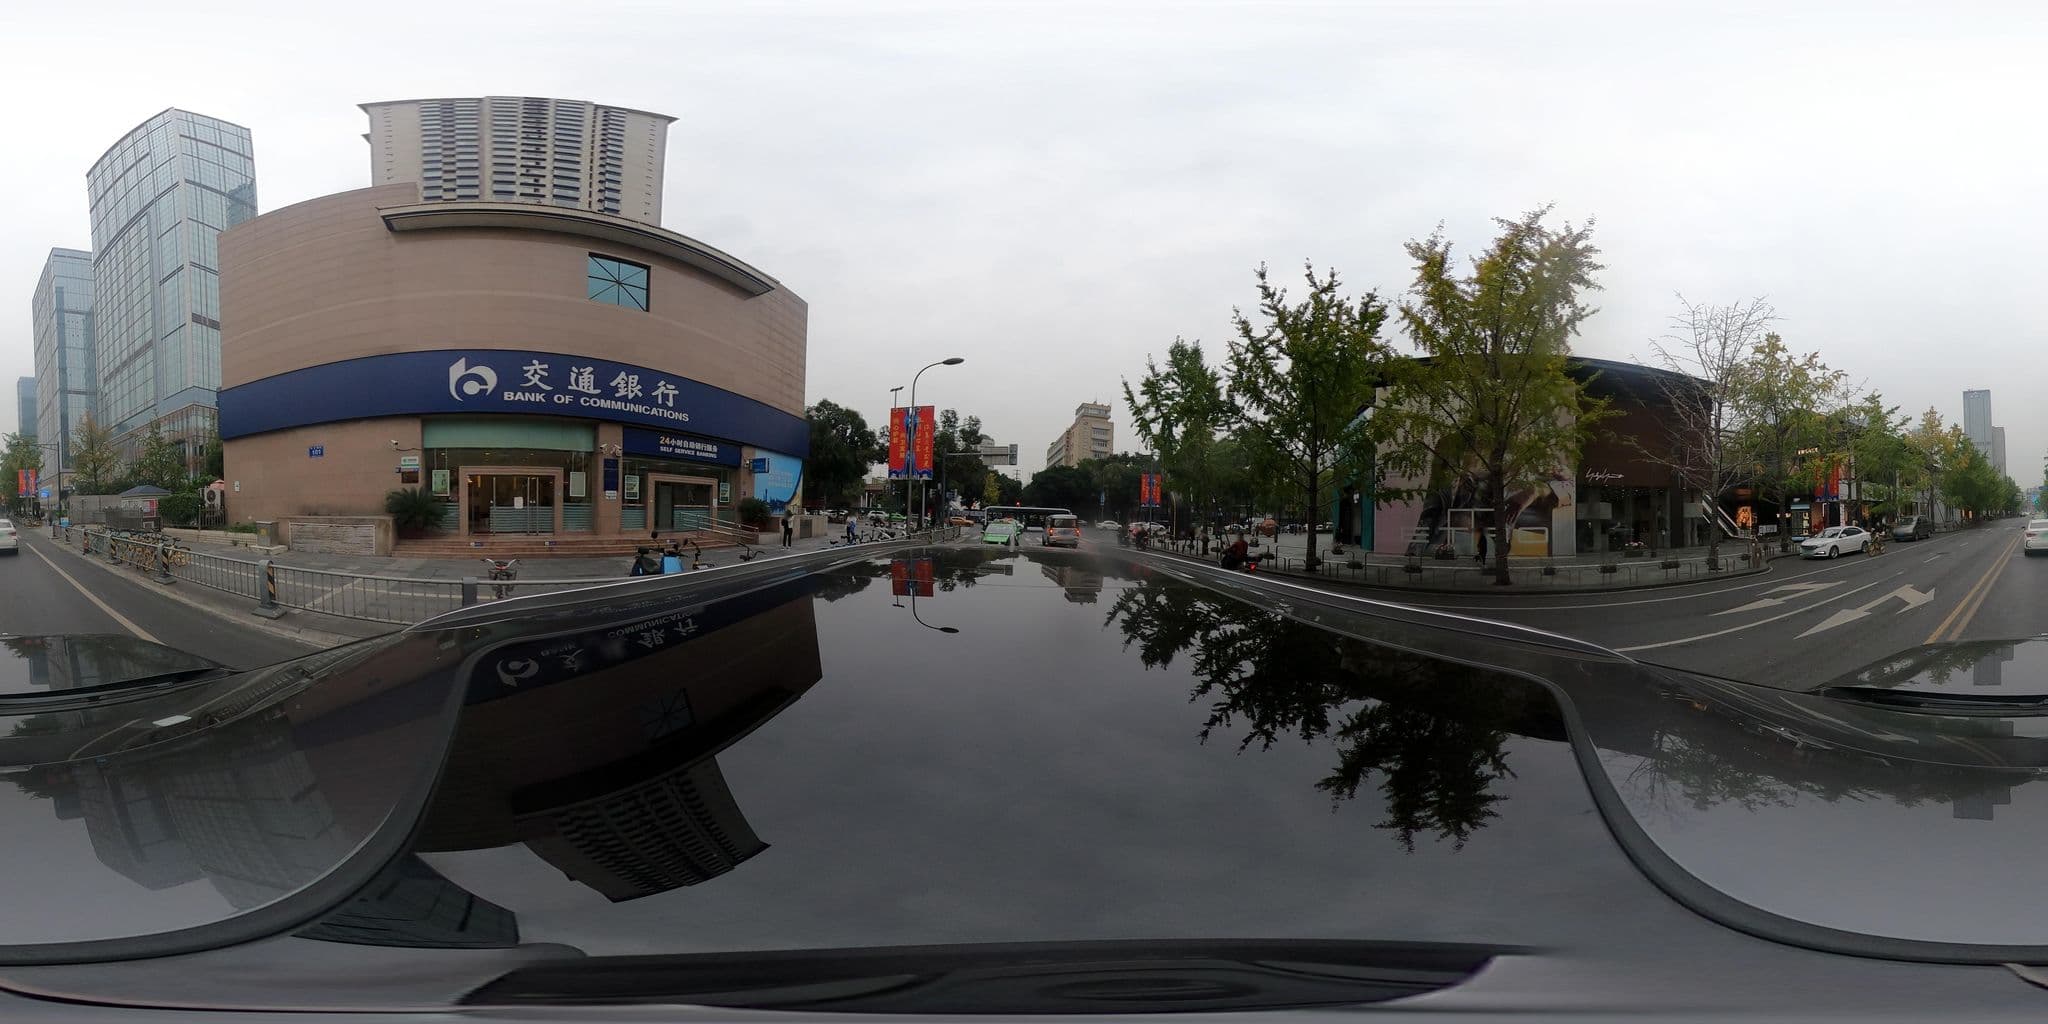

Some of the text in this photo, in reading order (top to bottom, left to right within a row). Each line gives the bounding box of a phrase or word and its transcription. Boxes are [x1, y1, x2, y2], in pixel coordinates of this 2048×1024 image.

[520, 359, 680, 408] 交通銀行
[503, 391, 689, 422] BANK OF COMMUNICATIONS
